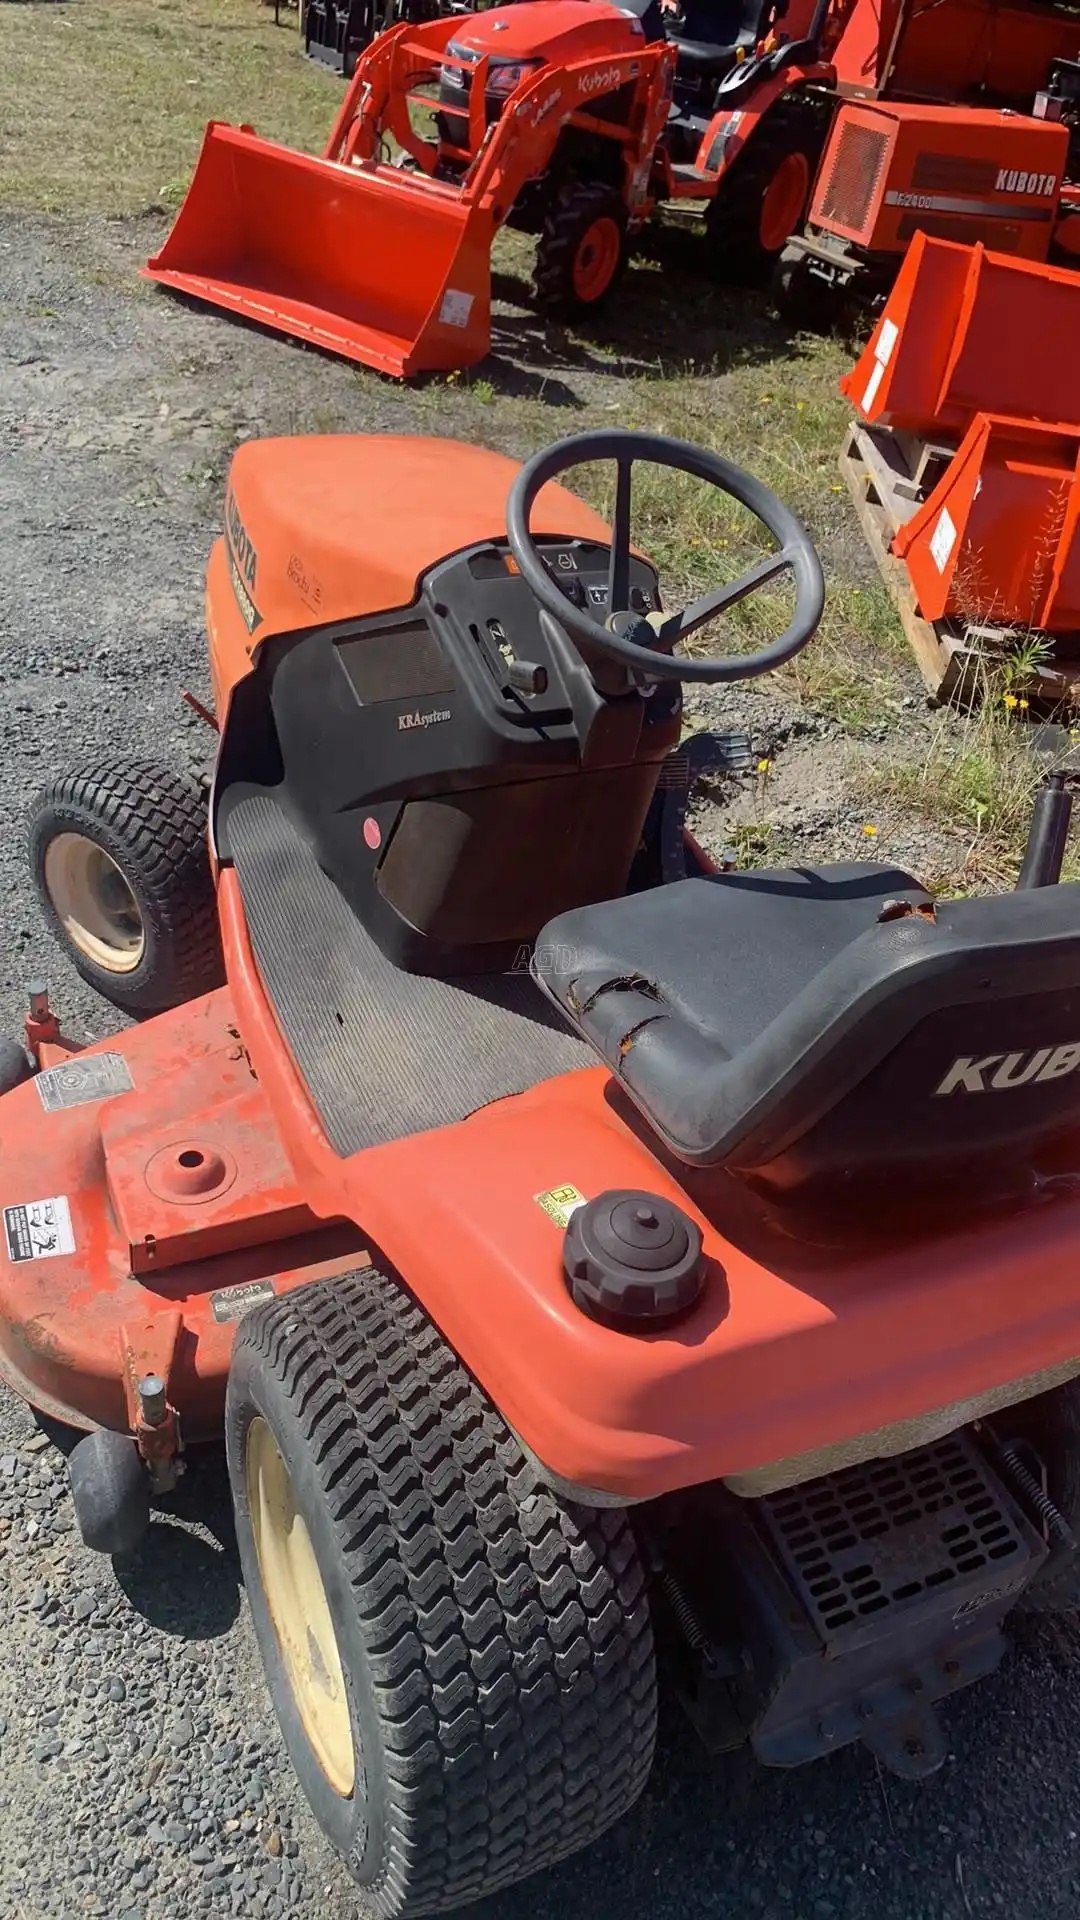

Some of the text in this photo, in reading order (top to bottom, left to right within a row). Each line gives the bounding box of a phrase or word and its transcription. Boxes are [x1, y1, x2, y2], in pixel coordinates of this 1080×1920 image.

[578, 67, 621, 93] Kubota
[995, 168, 1057, 197] KUBOTA
[397, 708, 451, 729] KRAsystem
[221, 1284, 261, 1300] Kubota
